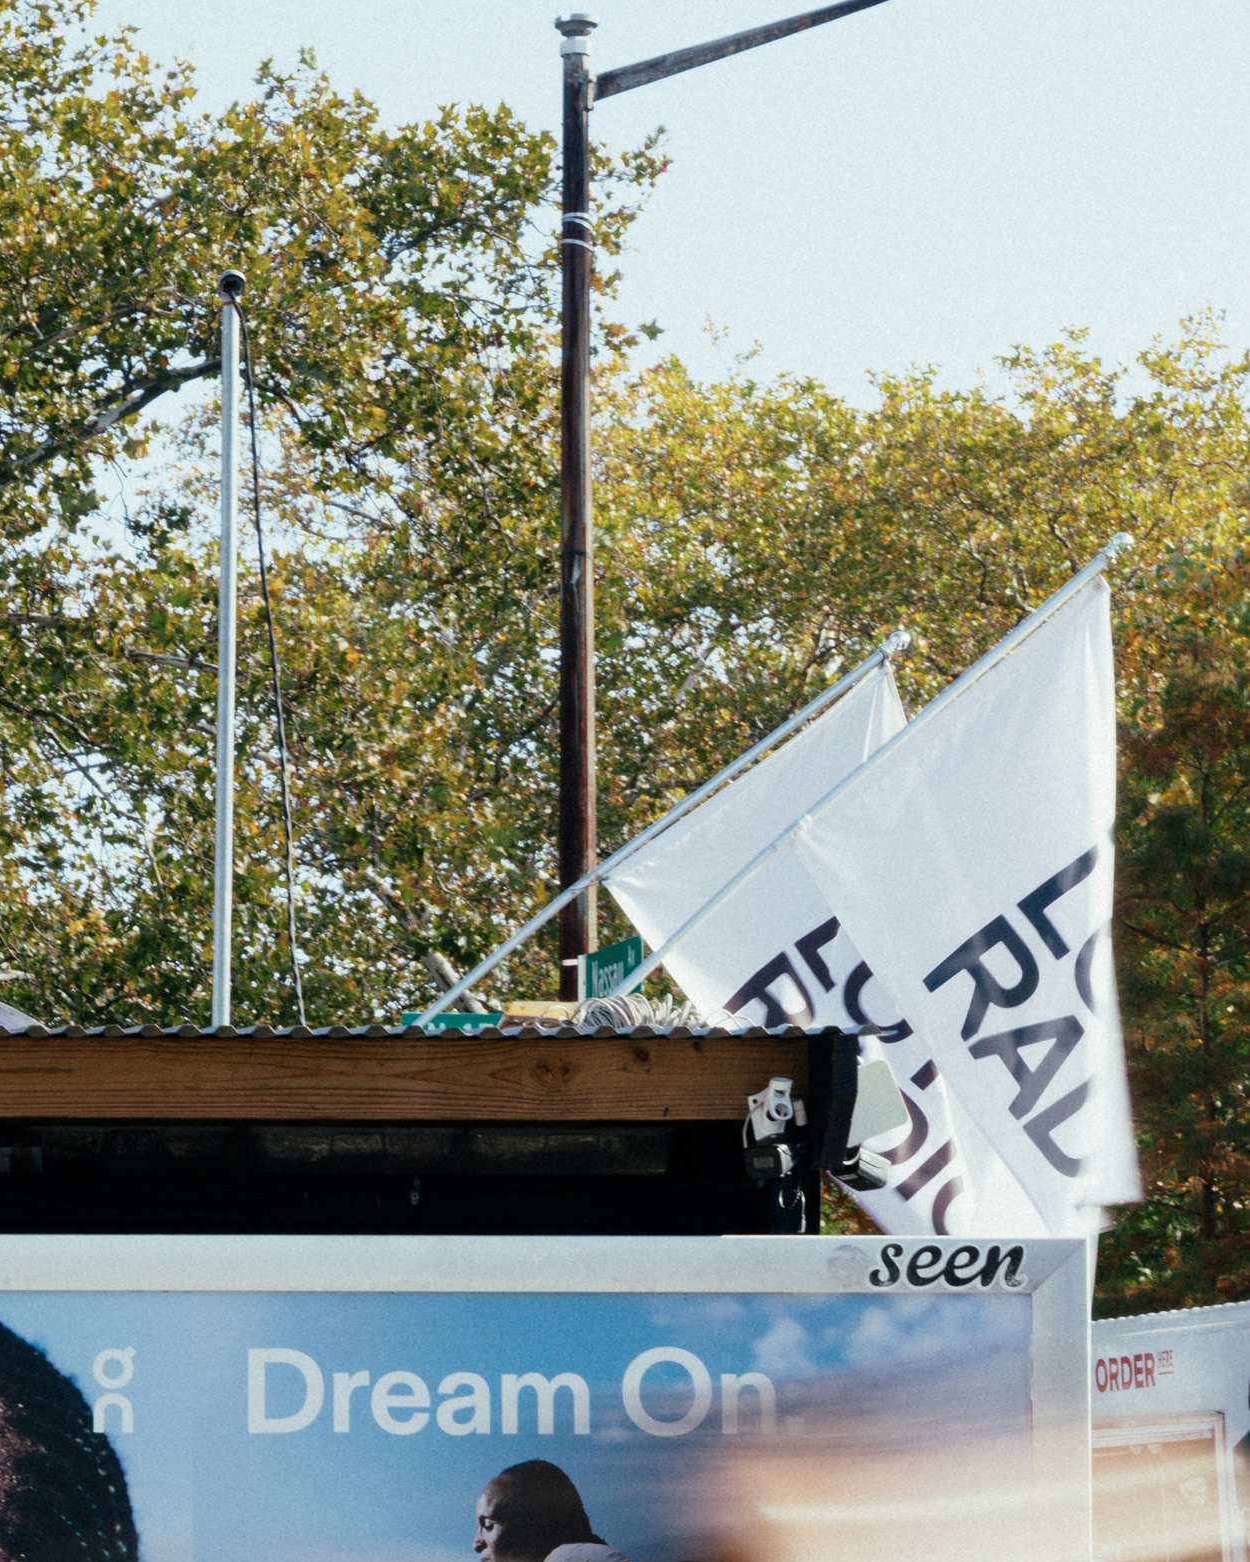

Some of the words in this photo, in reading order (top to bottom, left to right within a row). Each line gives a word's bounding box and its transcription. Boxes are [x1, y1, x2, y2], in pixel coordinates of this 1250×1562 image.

[867, 1242, 1026, 1288] seen
[248, 1347, 591, 1436] Dream
[1095, 1352, 1156, 1393] ORDER
